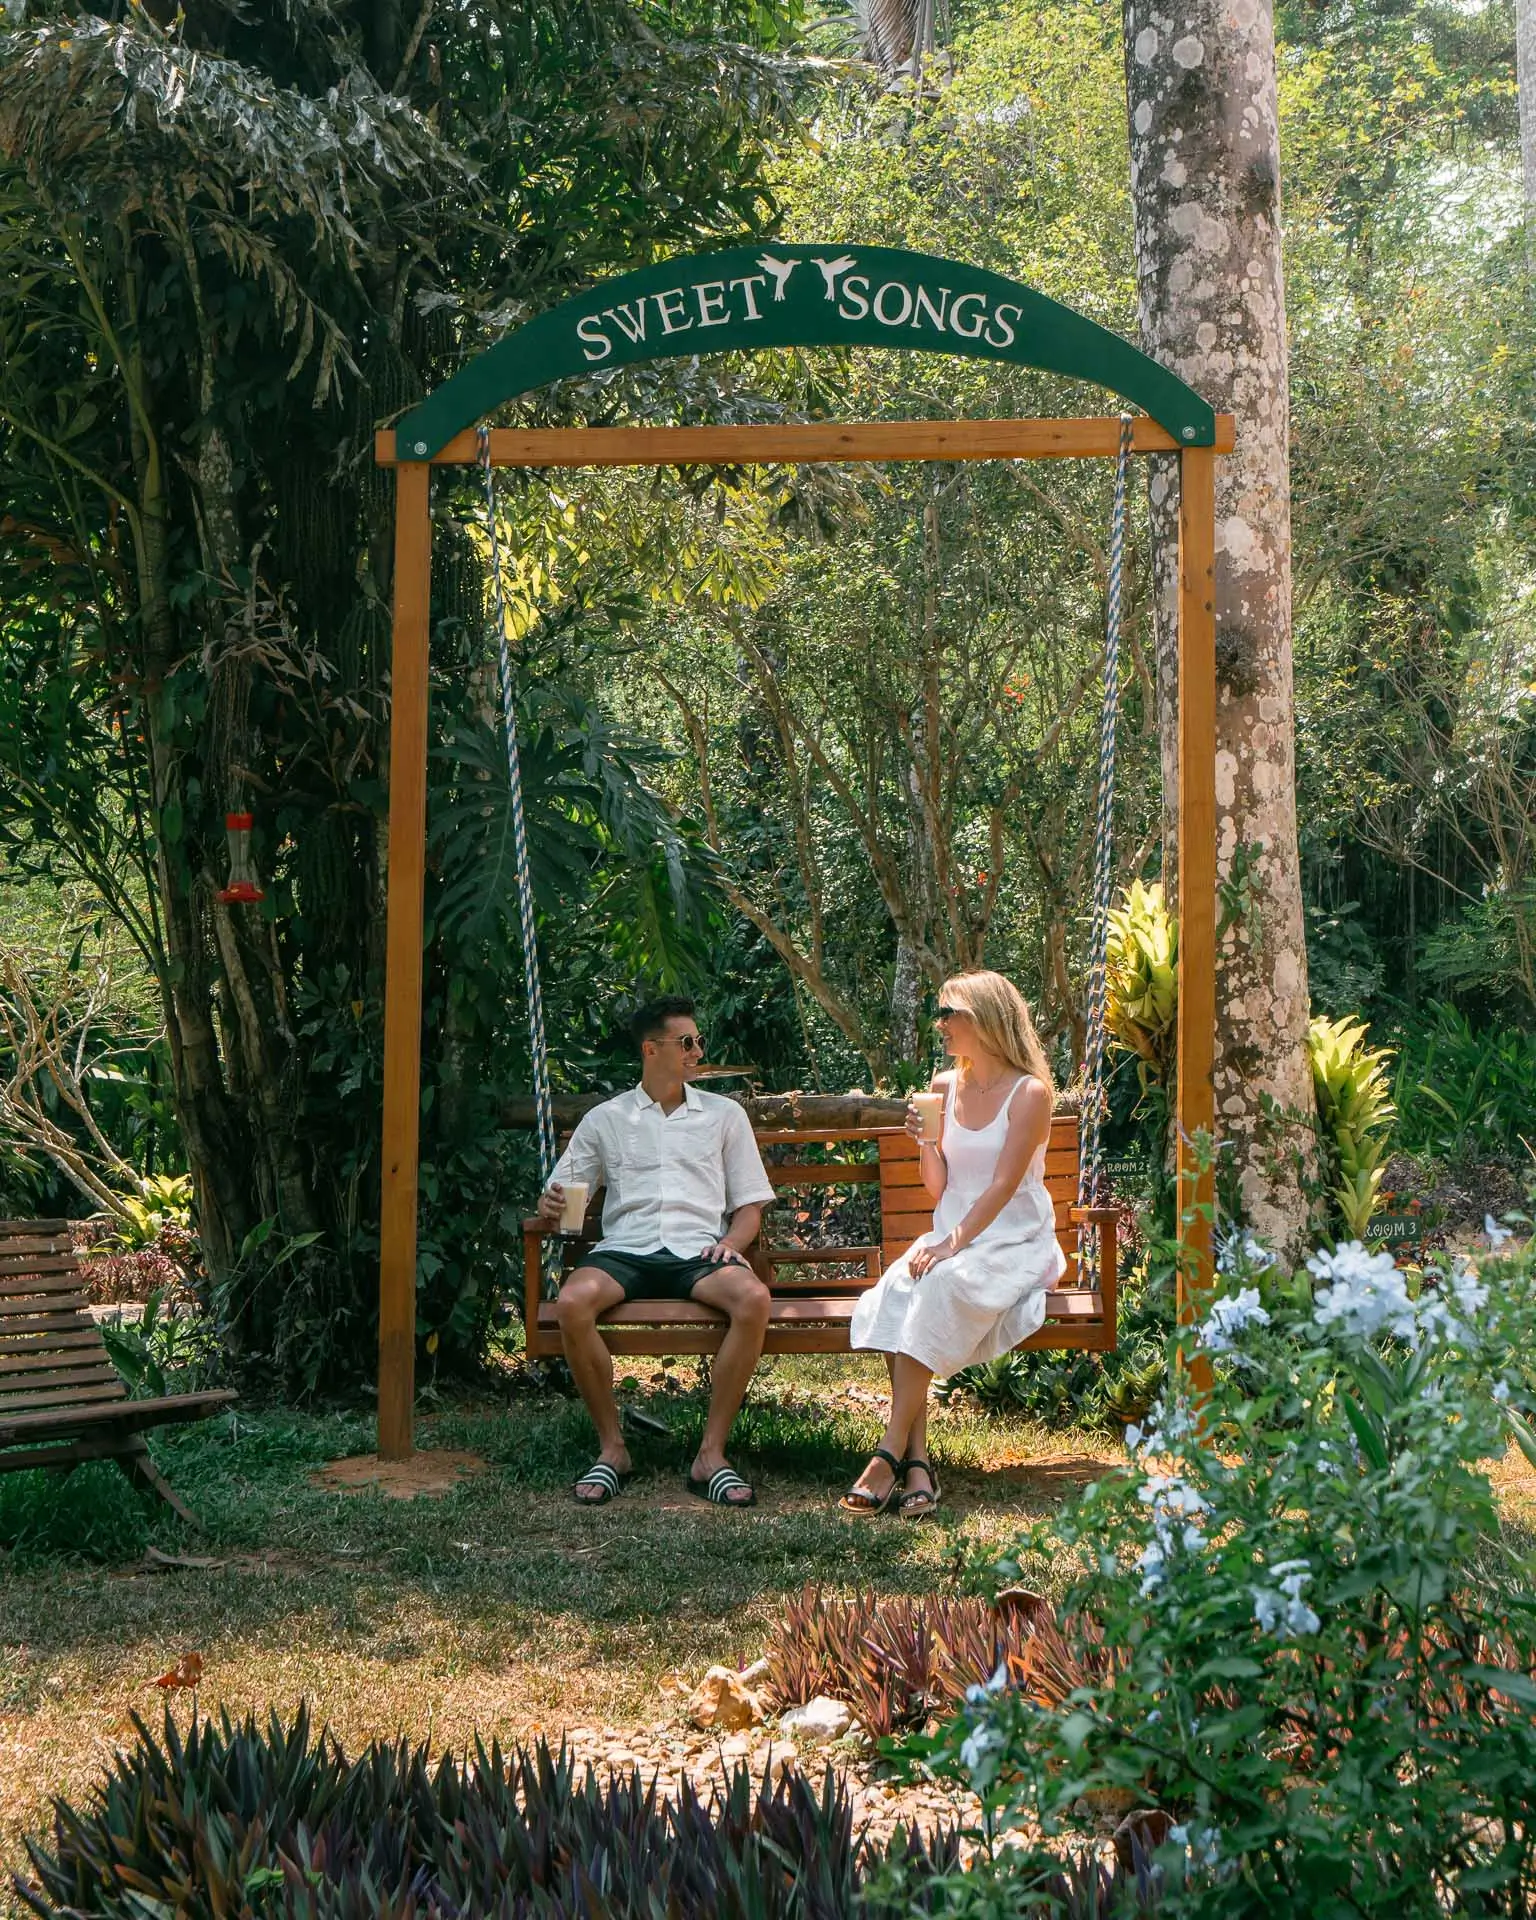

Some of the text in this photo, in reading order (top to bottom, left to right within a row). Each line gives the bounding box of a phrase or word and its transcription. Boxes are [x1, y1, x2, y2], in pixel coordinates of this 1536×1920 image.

[576, 274, 1023, 361] SWEET SONGS
[1107, 1162, 1144, 1173] ROOM 2
[1409, 1222, 1416, 1235] 3
